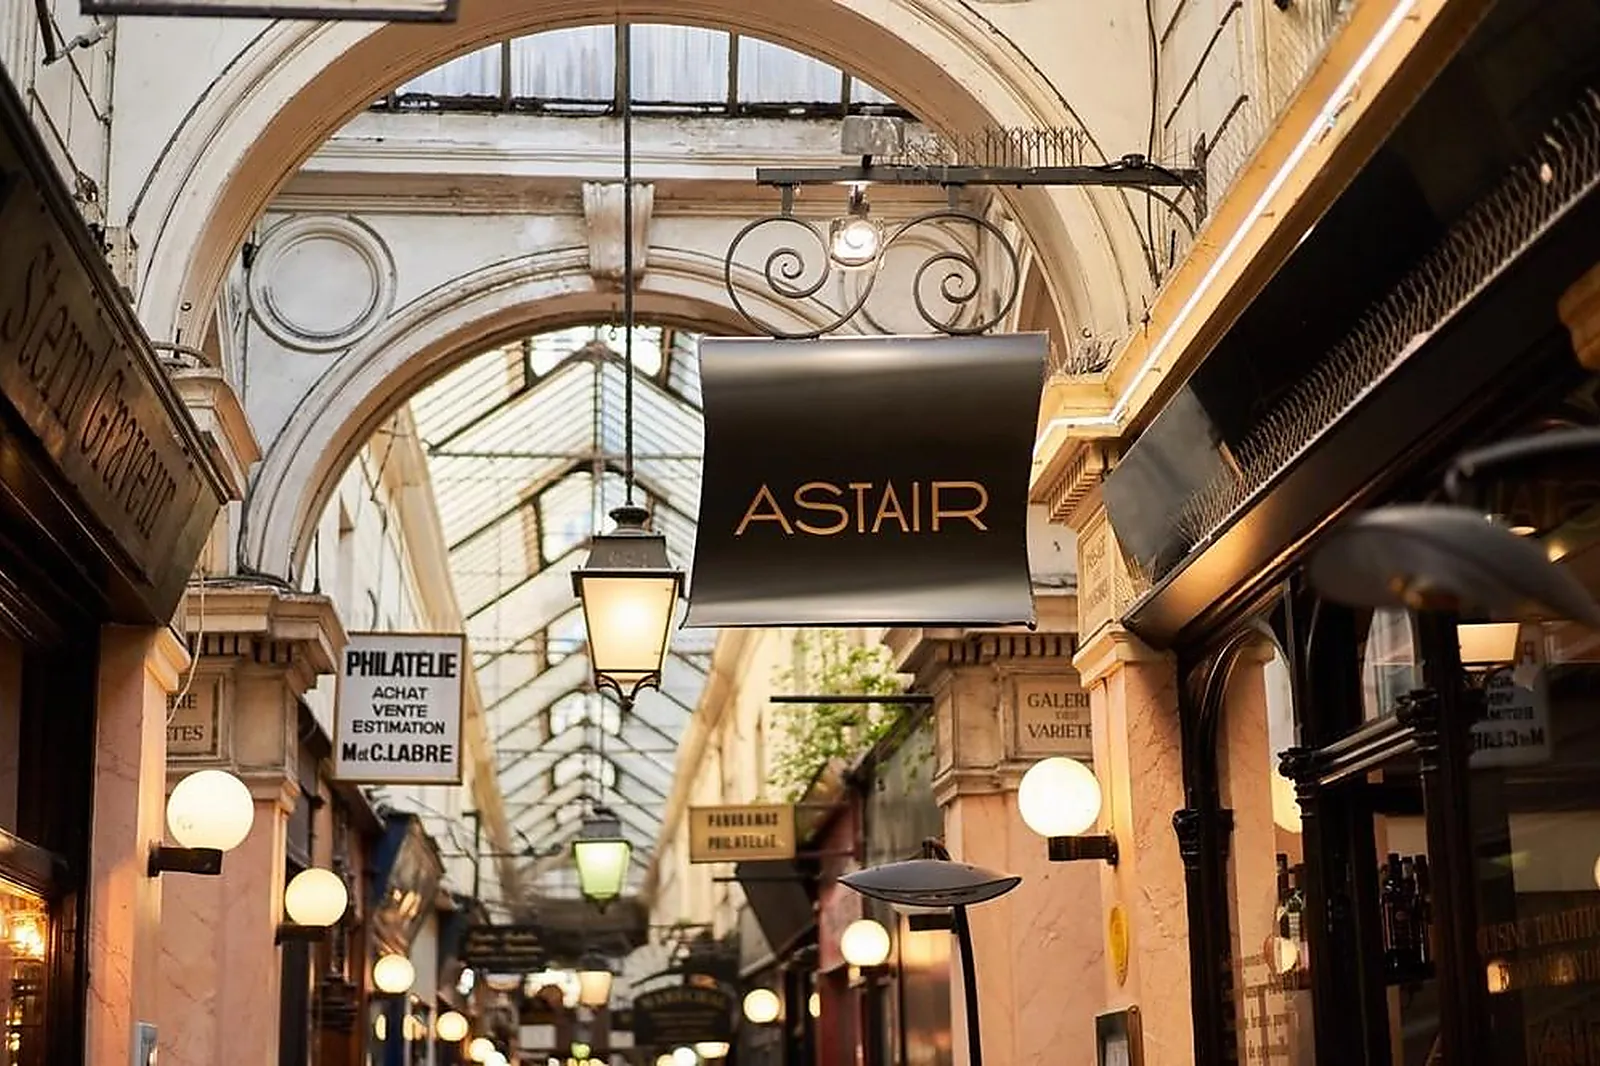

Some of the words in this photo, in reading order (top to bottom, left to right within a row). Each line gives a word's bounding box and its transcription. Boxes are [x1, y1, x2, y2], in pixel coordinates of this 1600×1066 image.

[80, 368, 178, 541] Graveur
[733, 478, 990, 536] ASTAIR
[167, 692, 197, 709] RIE
[372, 686, 428, 700] ACHAT
[372, 703, 428, 718] VENTE
[352, 719, 445, 735] ESTIMATION
